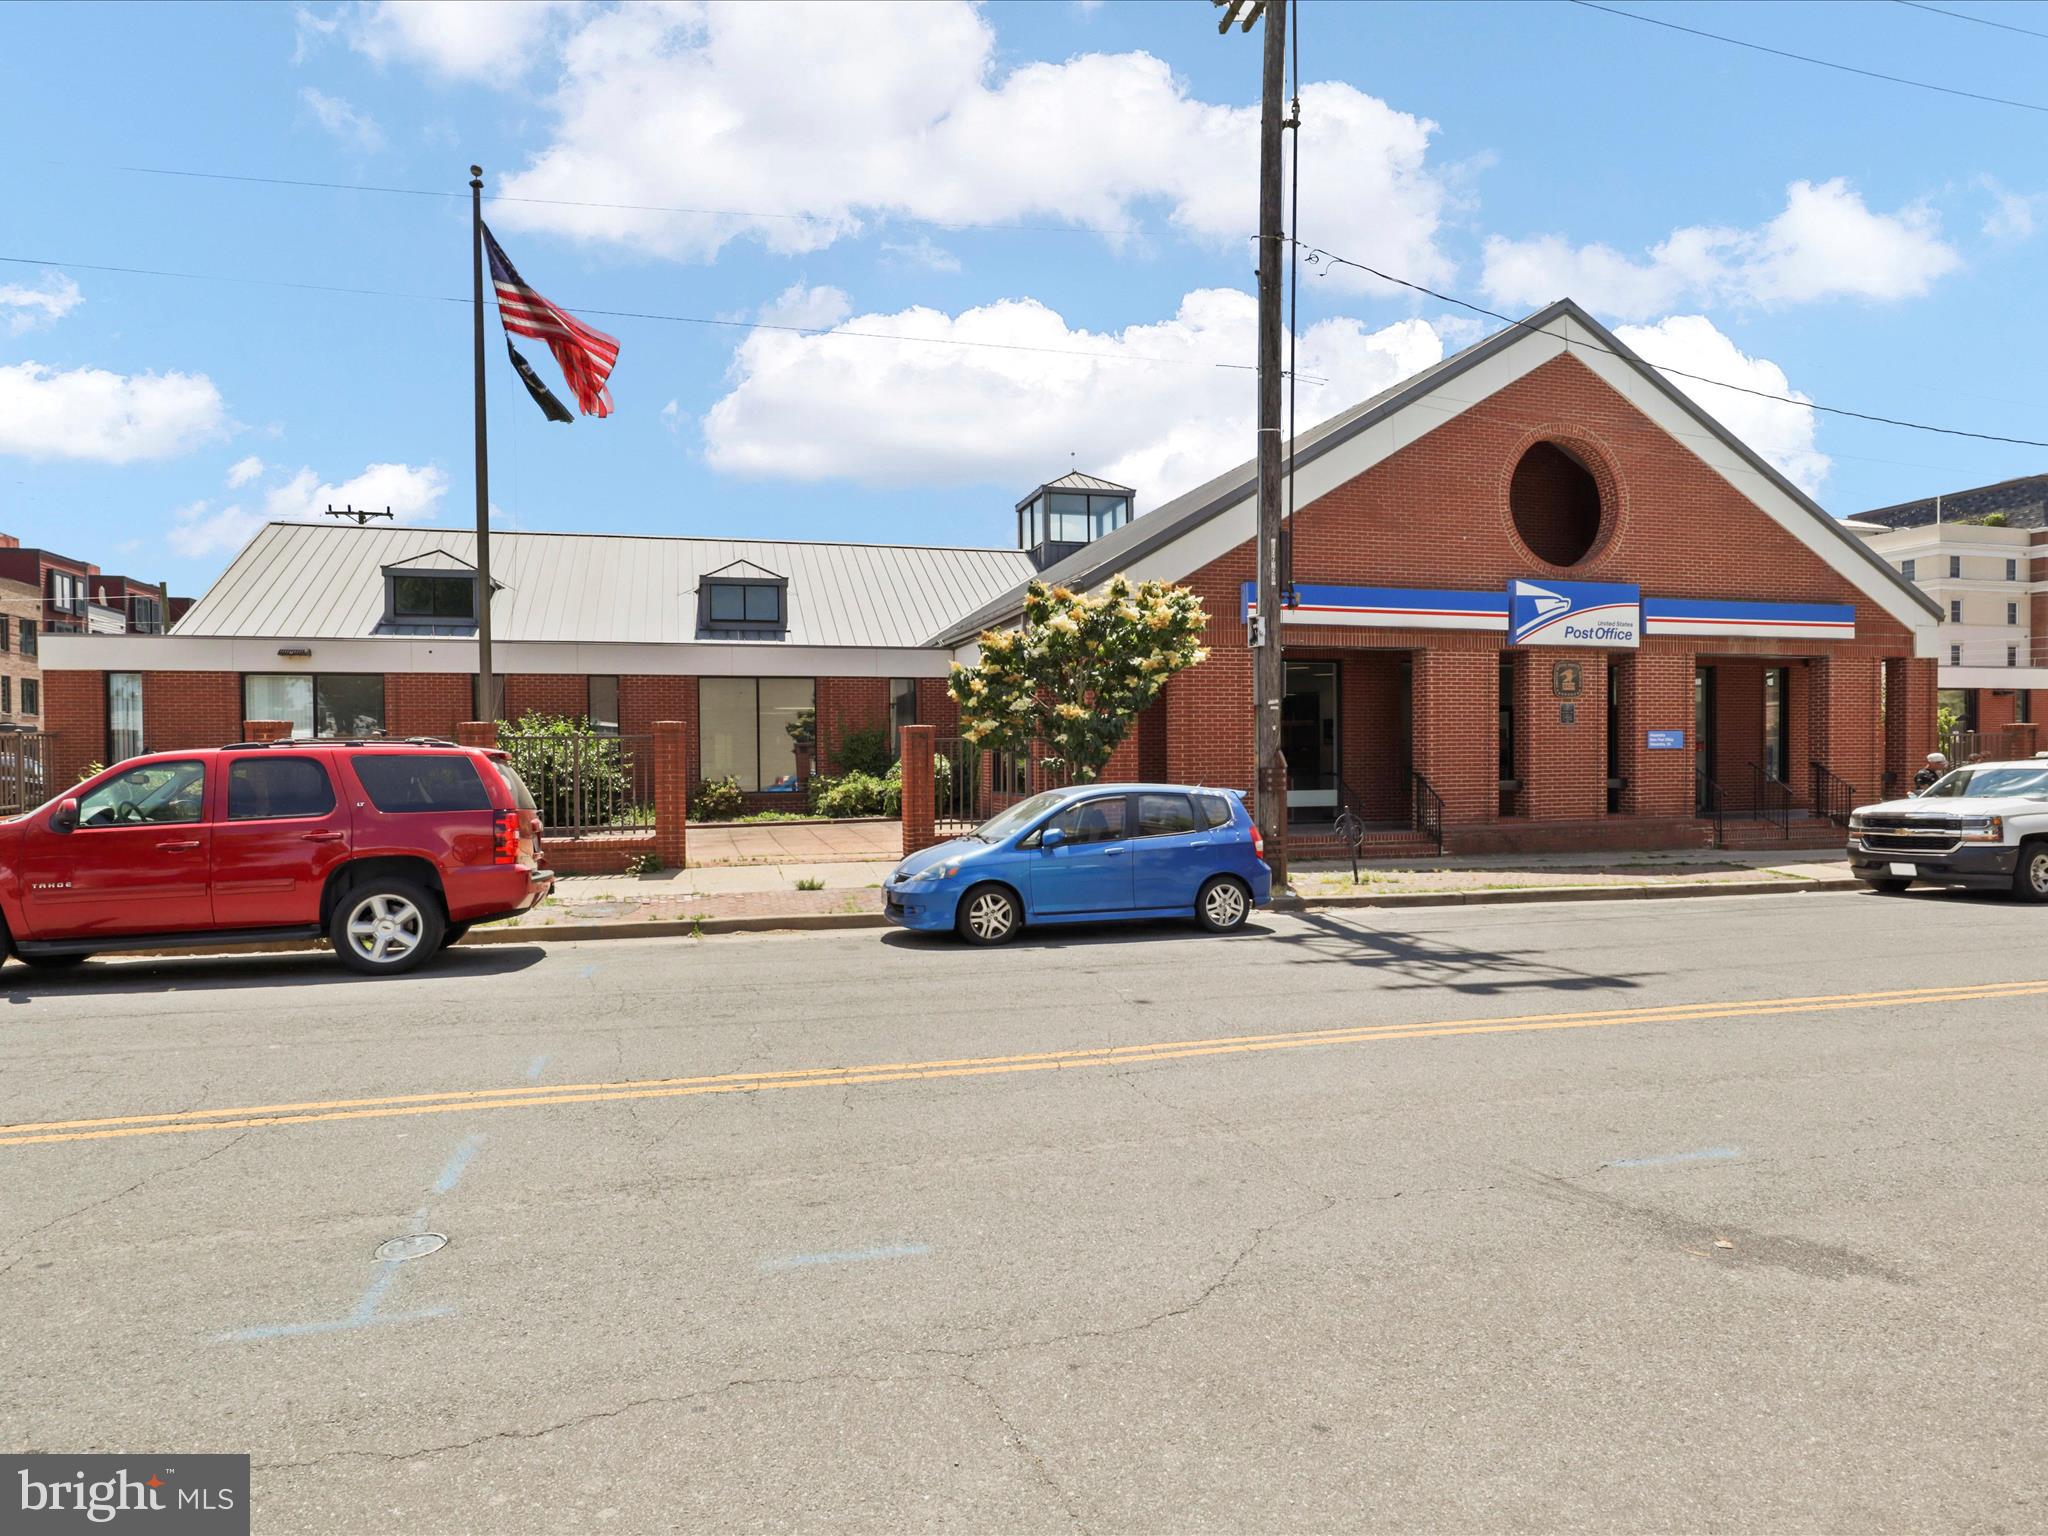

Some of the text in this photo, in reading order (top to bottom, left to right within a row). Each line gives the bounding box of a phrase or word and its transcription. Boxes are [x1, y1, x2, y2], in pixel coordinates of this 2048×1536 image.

[1564, 626, 1633, 640] Post Office
[32, 881, 72, 889] TAHOE
